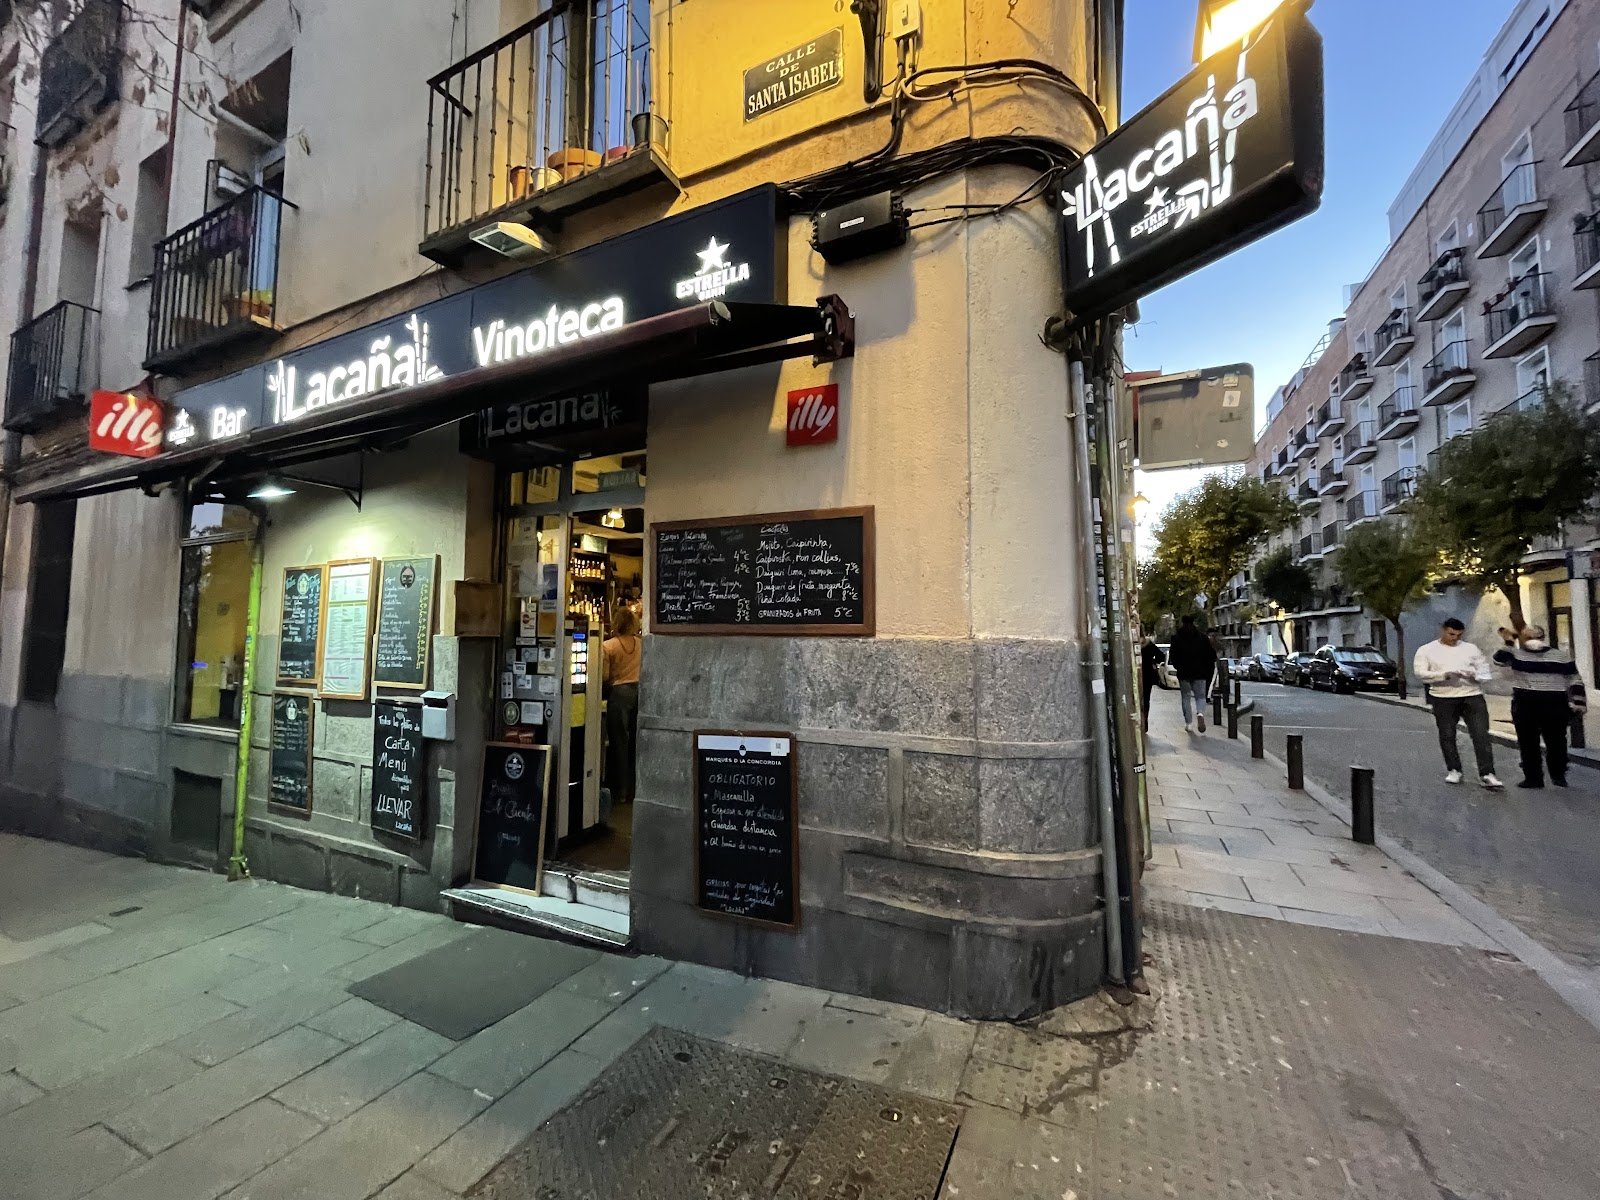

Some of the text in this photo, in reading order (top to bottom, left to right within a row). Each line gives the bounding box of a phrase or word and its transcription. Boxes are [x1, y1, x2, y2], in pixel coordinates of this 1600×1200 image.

[766, 42, 816, 73] CALLE
[779, 62, 800, 78] DE
[748, 60, 838, 114] SANTA ISABEL
[1075, 78, 1258, 232] Lacaña
[1130, 196, 1185, 239] ESTRELLA
[676, 263, 750, 299] ESTRELLA
[212, 297, 624, 440] Bar Lacaña Vinoteca
[97, 402, 163, 452] illy
[789, 394, 836, 437] illy
[385, 736, 410, 750] Carta
[378, 752, 407, 772] Menú
[708, 773, 776, 786] OBLIGATORIO
[377, 793, 412, 820] LLEVAR
